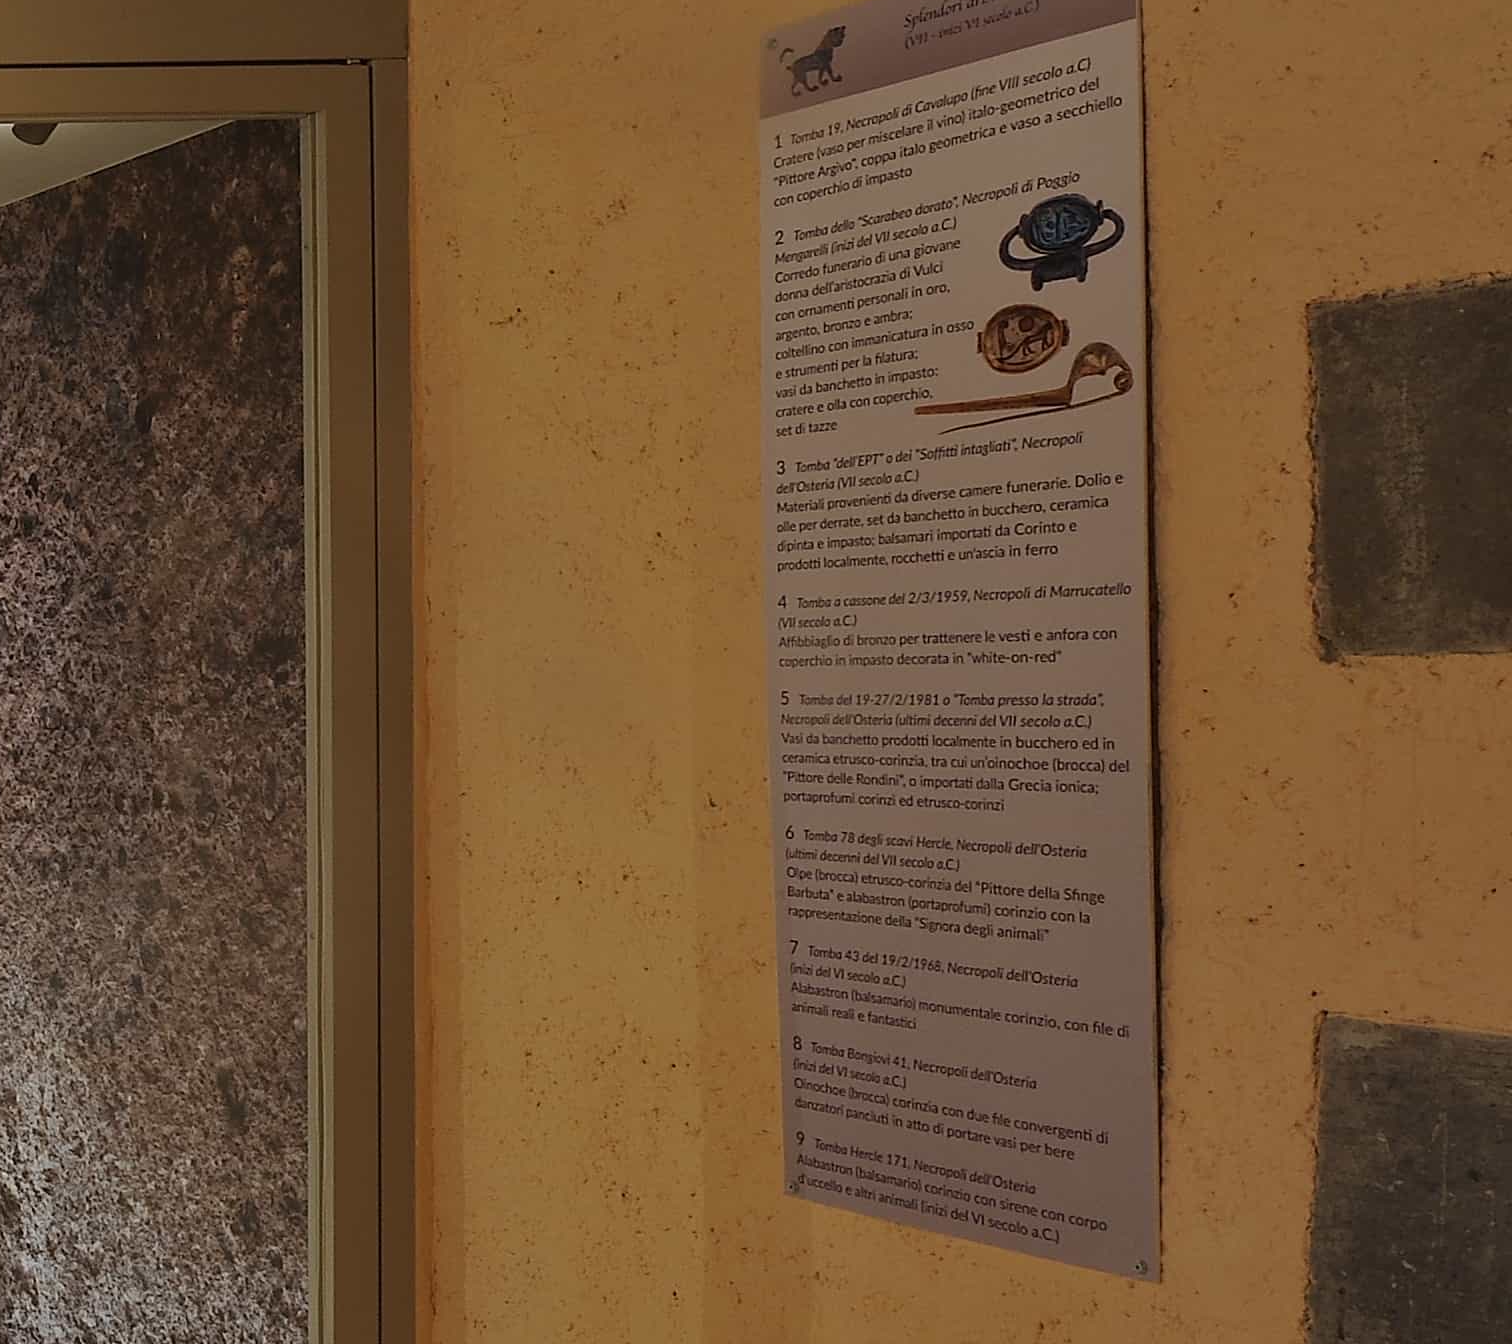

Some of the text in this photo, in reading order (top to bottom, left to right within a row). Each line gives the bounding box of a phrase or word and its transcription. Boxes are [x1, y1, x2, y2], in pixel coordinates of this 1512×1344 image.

[775, 135, 783, 149] 1
[791, 129, 825, 145] Tomba
[828, 122, 844, 137] 19,
[846, 108, 899, 131] Necropoli
[901, 103, 913, 117] di
[914, 92, 969, 114] Cavalupo
[998, 75, 1020, 91] VIII
[1023, 65, 1063, 87] secolo
[777, 594, 787, 609] 4
[797, 597, 832, 609] Tomba
[843, 596, 887, 607] cassone
[888, 592, 906, 605] del
[973, 586, 1031, 603] Necropoli
[1034, 585, 1047, 599] di
[1049, 582, 1132, 598] Marrucatello
[779, 654, 833, 668] coperchio
[835, 657, 846, 665] in
[849, 654, 894, 667] impasto
[897, 653, 950, 665] decorata
[952, 652, 964, 664] in
[780, 732, 1115, 750] Vasi da banchetto prodotti localmente in bucchero ed in
[791, 1001, 917, 1030] animali reali e fantastici
[795, 1130, 805, 1146] 9
[815, 1138, 848, 1156] Tomba
[850, 1145, 883, 1164] Hercle
[913, 1159, 967, 1181] Necropoli
[844, 1186, 853, 1196] e
[854, 1186, 876, 1201] altri
[878, 1193, 918, 1210] animali
[950, 1207, 969, 1222] del
[970, 1210, 985, 1227] VI
[987, 1218, 1029, 1236] secolo
